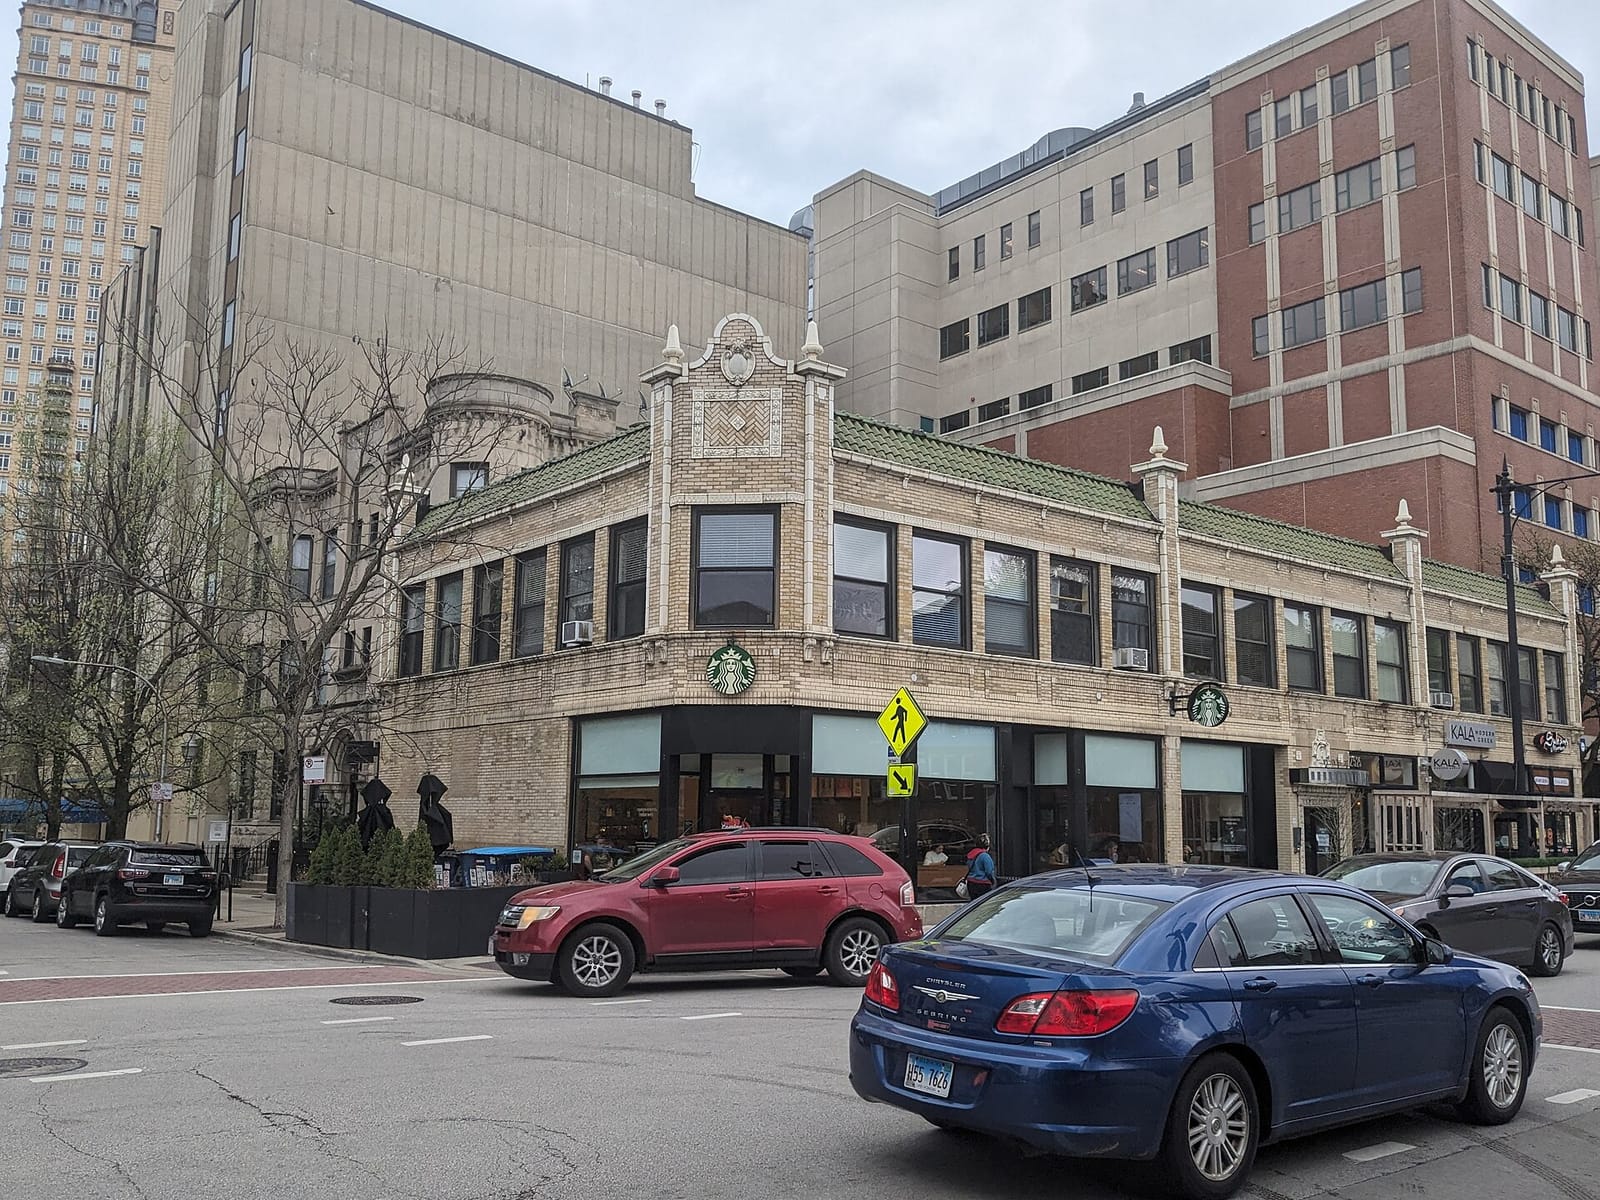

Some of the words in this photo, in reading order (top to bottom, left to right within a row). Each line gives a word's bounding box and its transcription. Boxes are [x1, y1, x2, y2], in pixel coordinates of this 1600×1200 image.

[1450, 724, 1475, 741] KALA
[1433, 759, 1460, 768] KALA
[926, 977, 967, 989] CHRYSLER
[916, 1008, 967, 1023] SEBRING
[907, 1063, 925, 1083] H55
[929, 1068, 949, 1090] 7626
